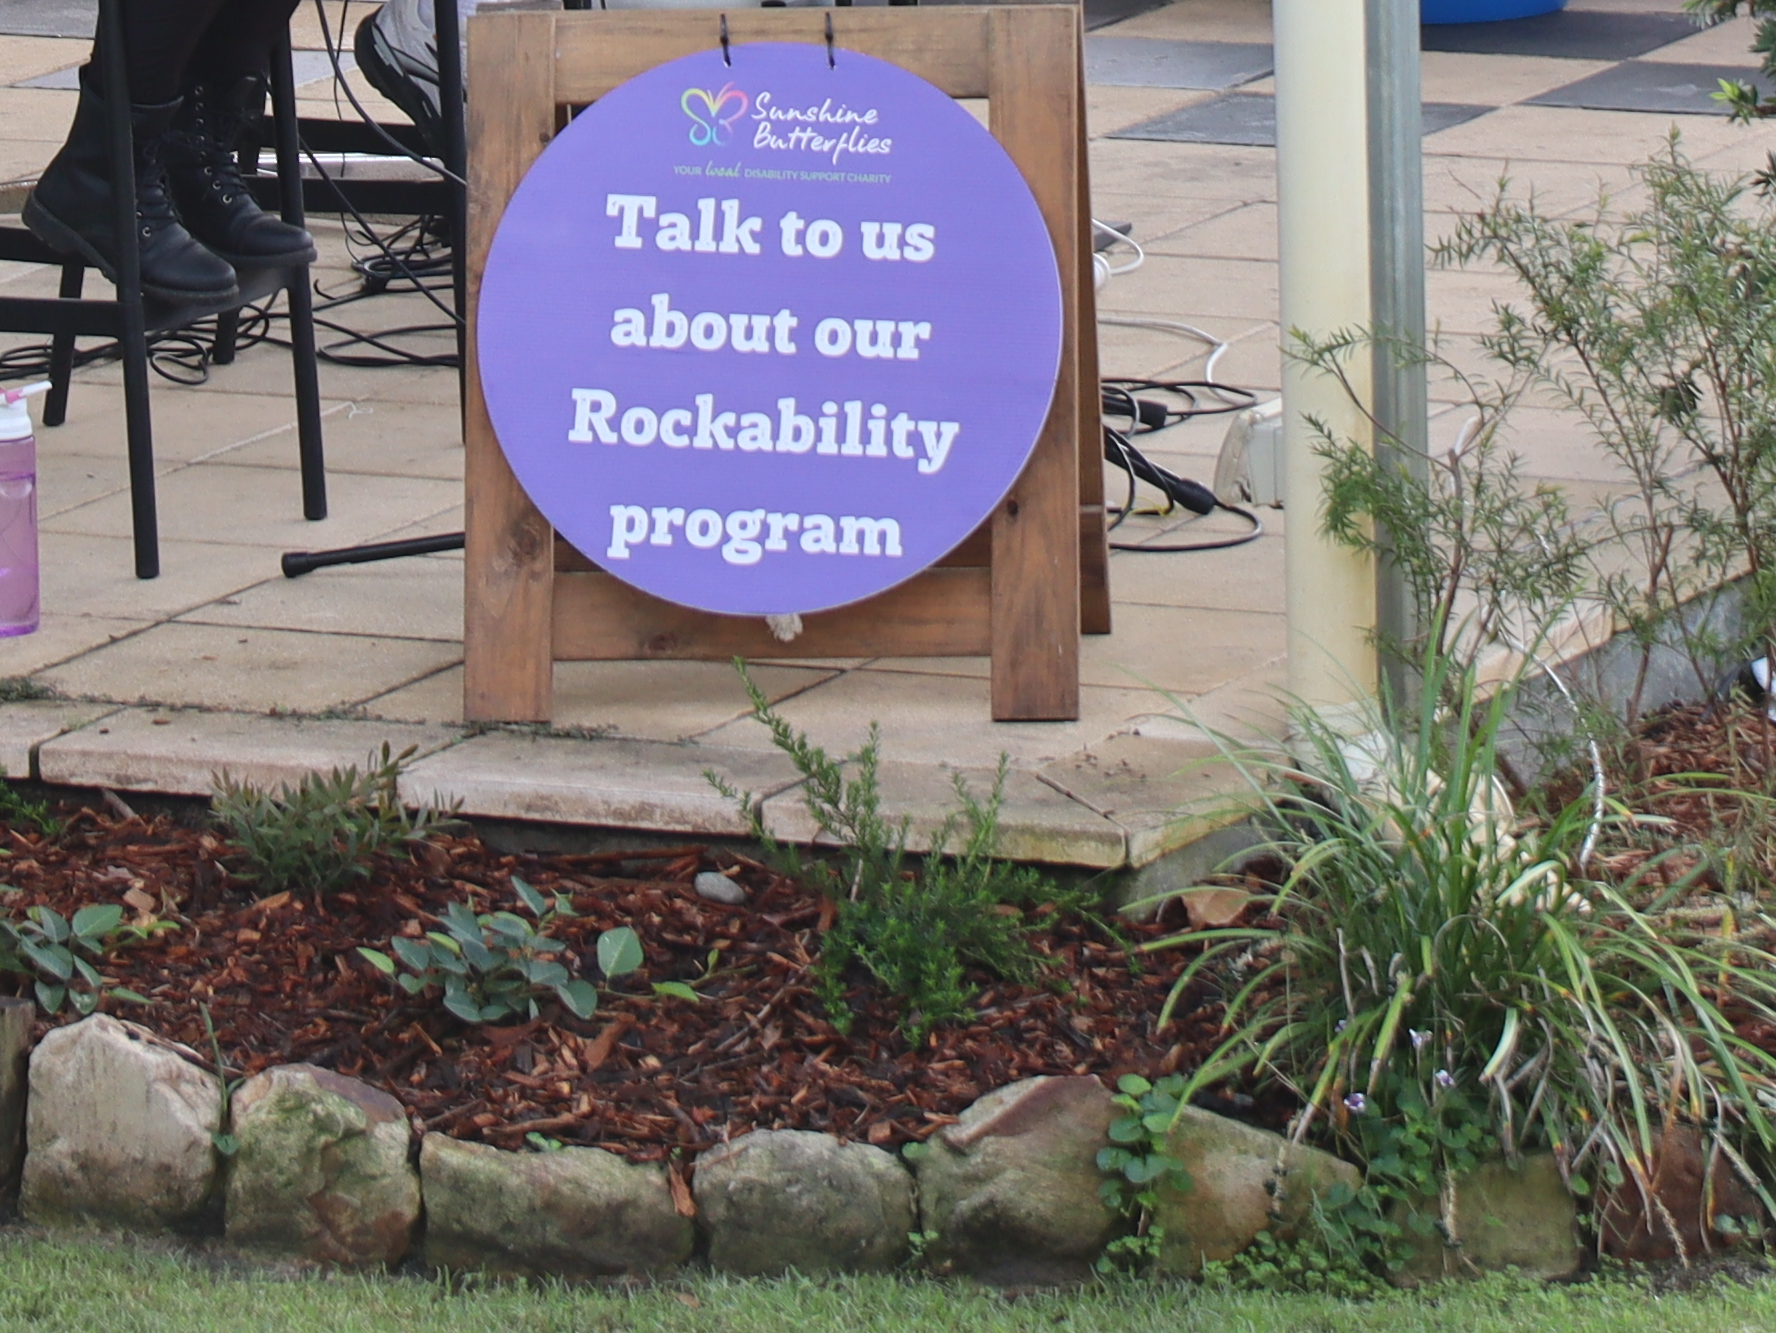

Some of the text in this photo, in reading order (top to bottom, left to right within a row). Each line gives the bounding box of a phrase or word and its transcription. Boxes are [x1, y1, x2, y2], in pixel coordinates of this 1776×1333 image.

[750, 90, 879, 124] Sunshine
[673, 160, 892, 183] YOUR local DISABILITY SUPPORT CHARITY
[752, 121, 893, 165] Butterflies
[605, 193, 936, 262] Talk to us
[610, 292, 932, 360] about our
[567, 387, 960, 474] Rockability
[606, 504, 903, 565] program
